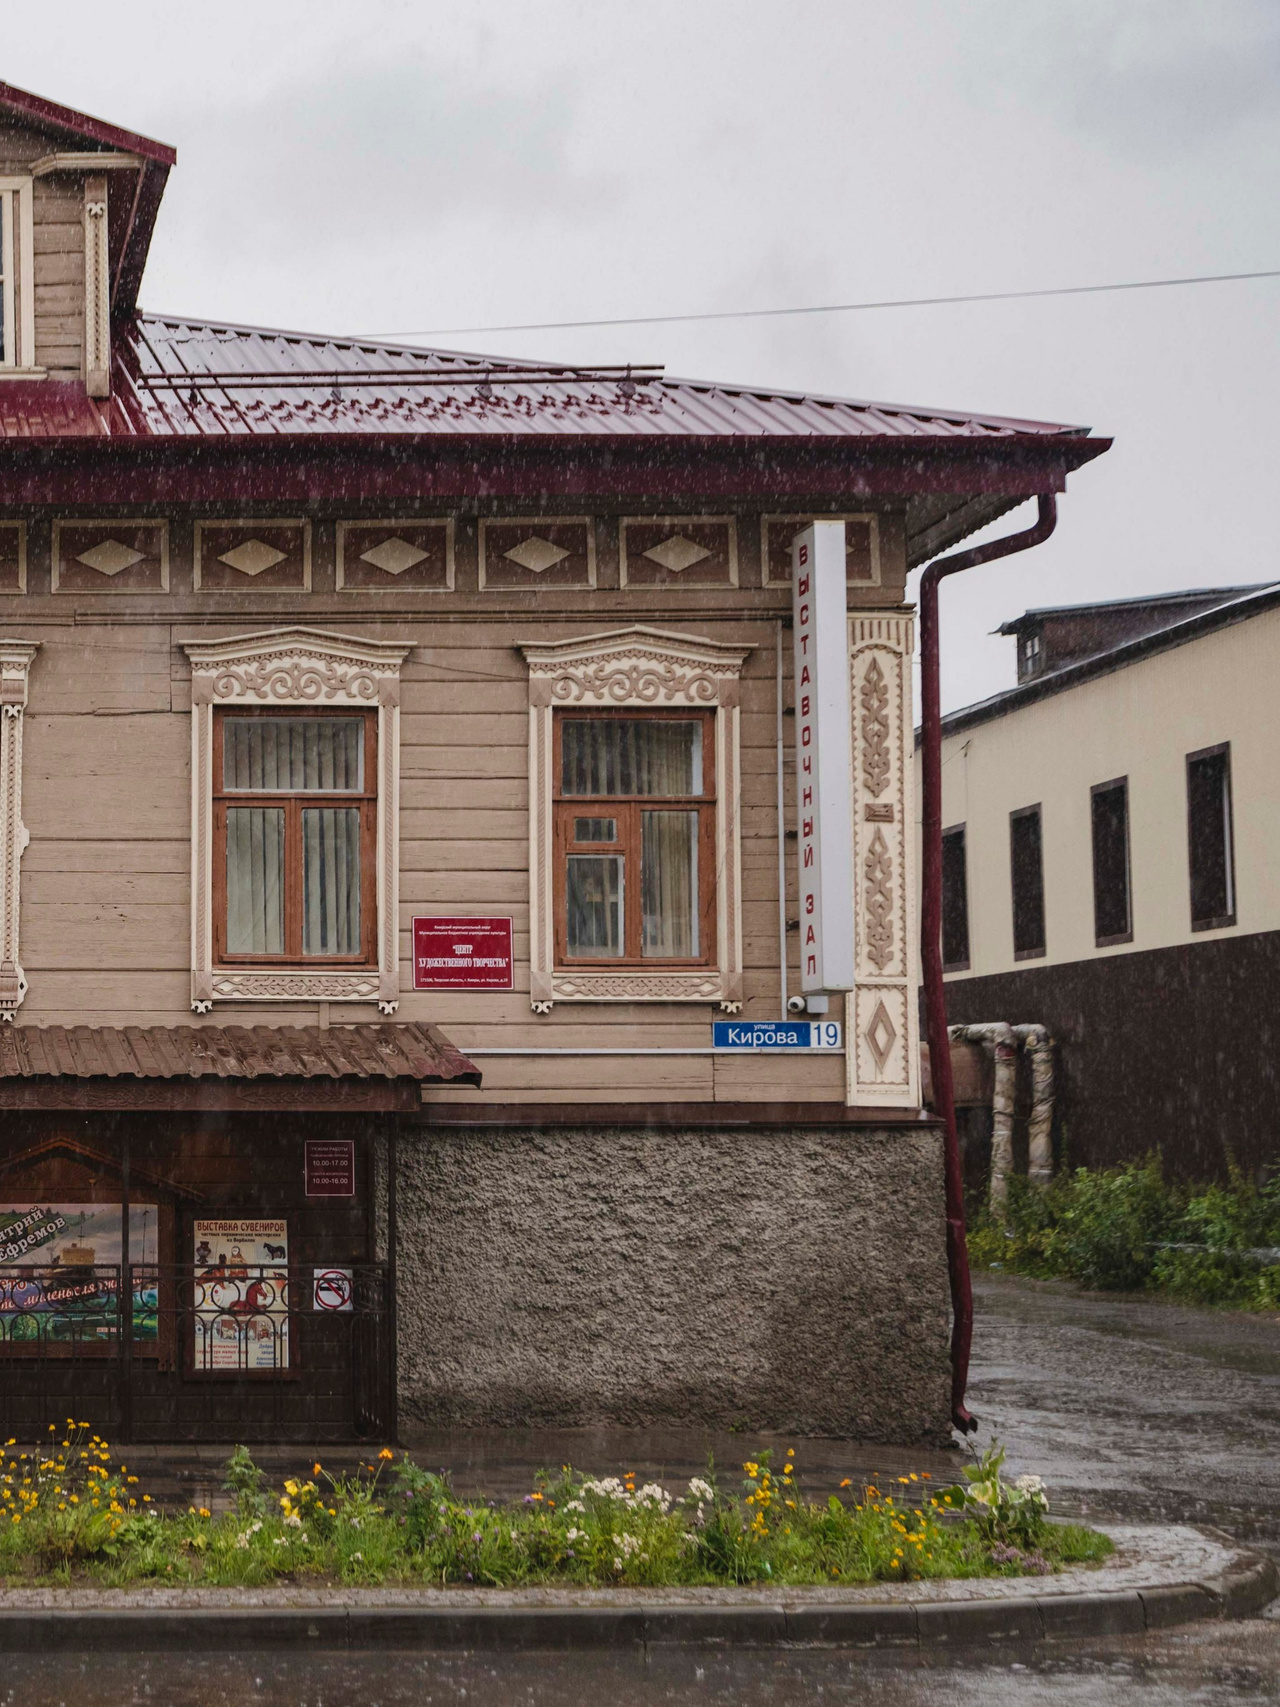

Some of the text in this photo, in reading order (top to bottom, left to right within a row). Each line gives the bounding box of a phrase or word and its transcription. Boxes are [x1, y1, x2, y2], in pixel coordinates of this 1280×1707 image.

[798, 544, 816, 976] ВЫСТАВОЧНЫЙ ЗАЛ
[728, 1023, 838, 1047] Кирова 19
[197, 1222, 285, 1232] ВЫСТАВКА СУВЕНИРОВ
